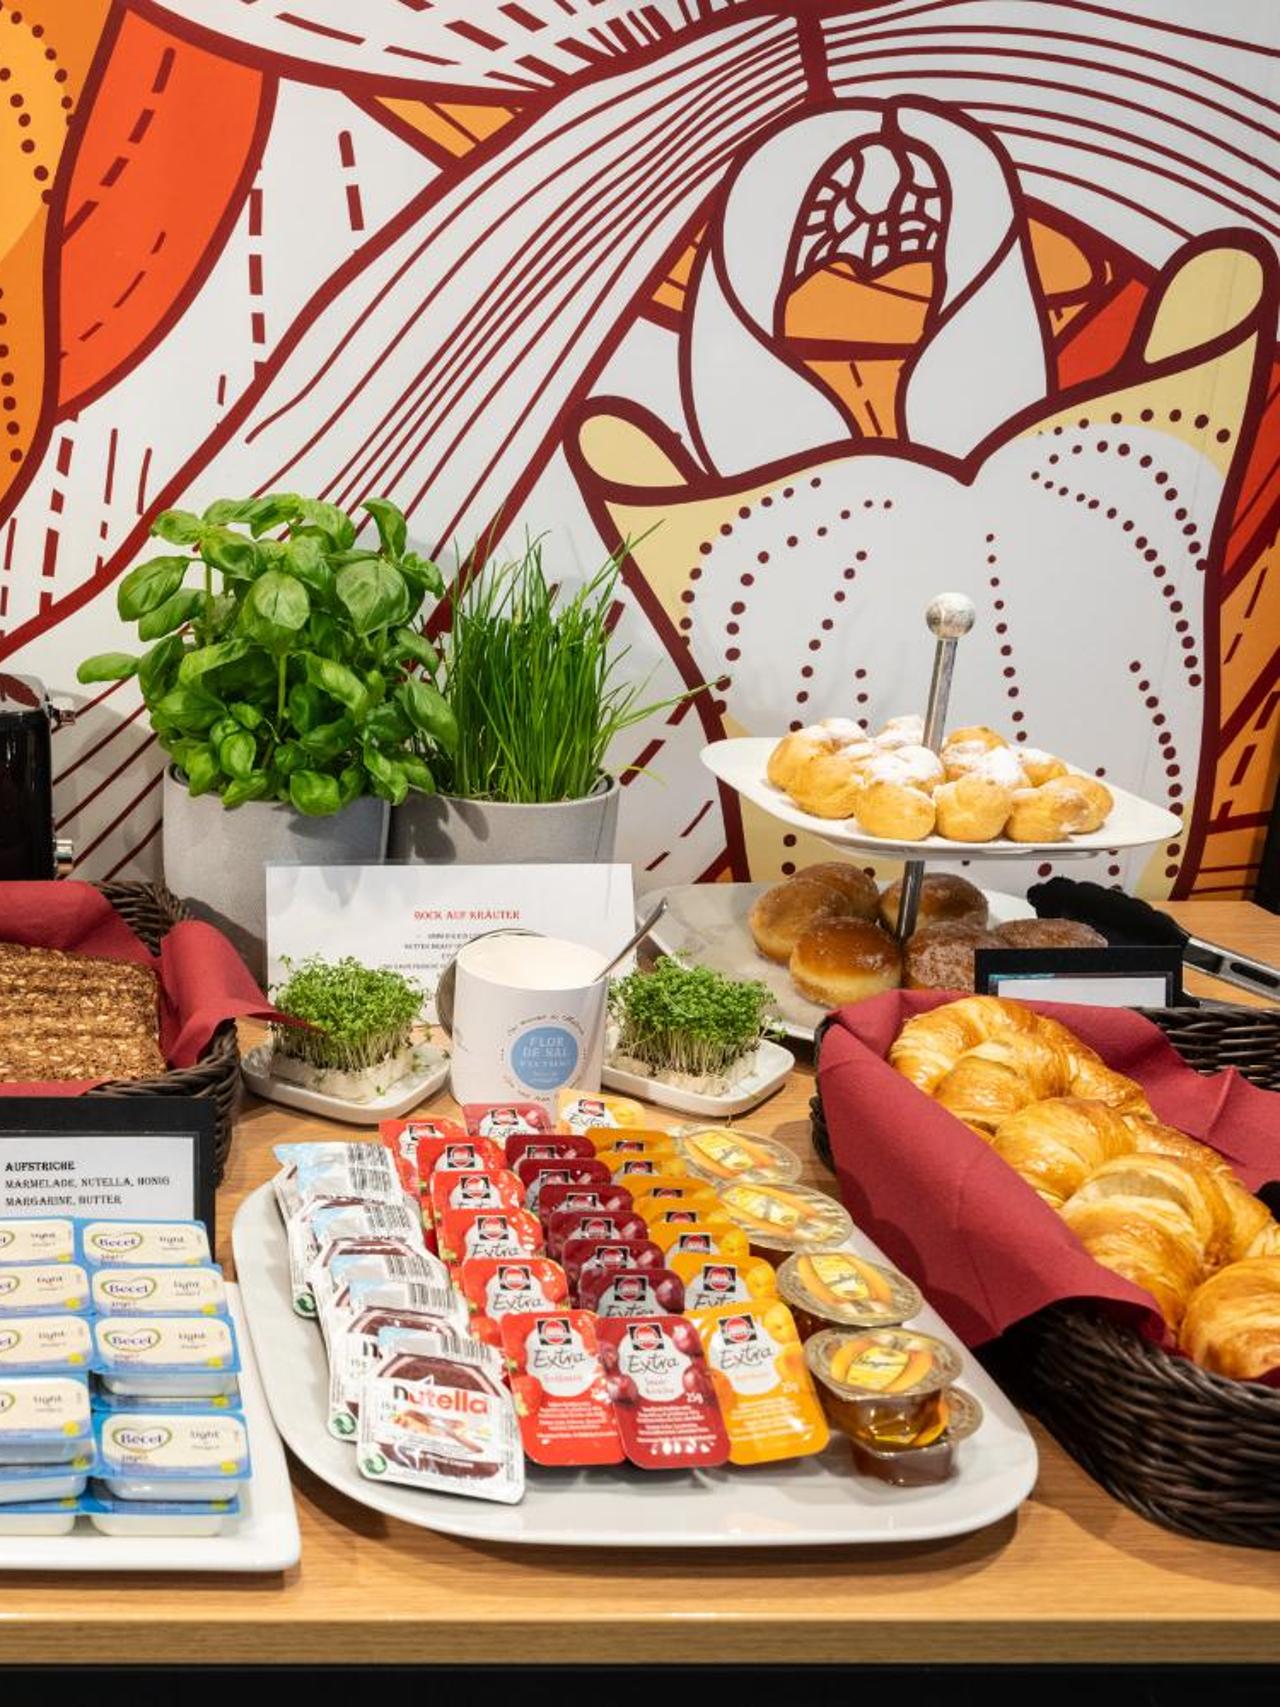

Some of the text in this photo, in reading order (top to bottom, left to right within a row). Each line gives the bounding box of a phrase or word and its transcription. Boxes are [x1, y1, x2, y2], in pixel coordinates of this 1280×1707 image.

[446, 910, 466, 920] AUF
[528, 1036, 565, 1047] FLOR
[4, 1160, 76, 1172] AUFSTRICHE
[5, 1175, 171, 1189] MARMELADE, NUTELLA, HONIG
[5, 1194, 123, 1207] MARGARINE, BUTTER
[493, 1293, 544, 1312] Extra
[533, 1349, 586, 1370] Extra
[628, 1353, 680, 1374] Extra
[720, 1343, 772, 1369] Extra
[394, 1384, 488, 1414] nutella
